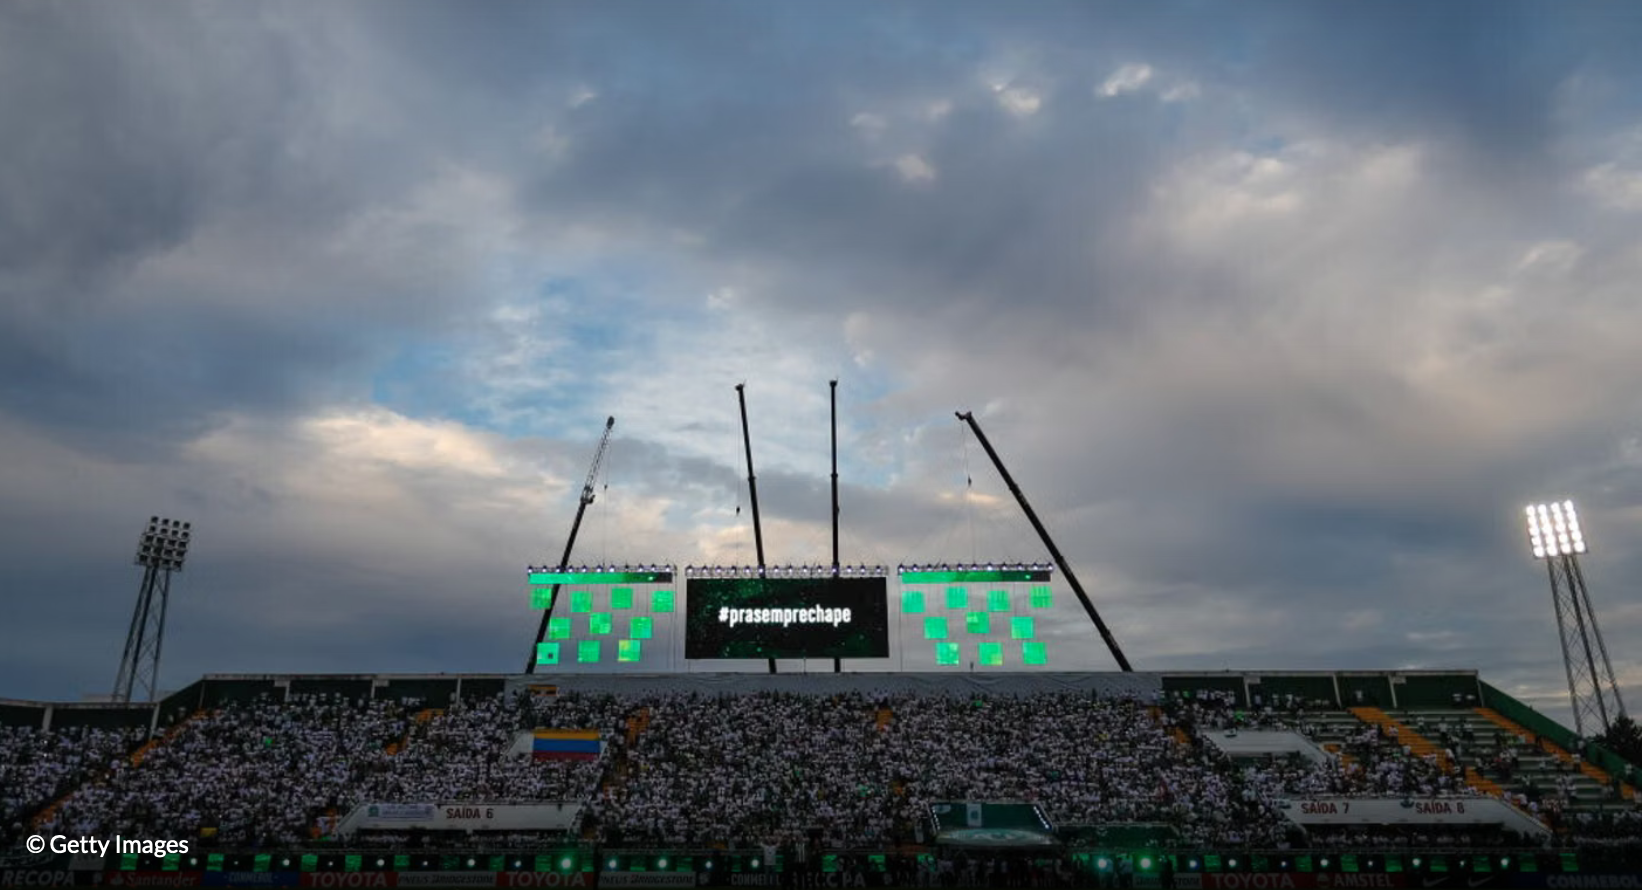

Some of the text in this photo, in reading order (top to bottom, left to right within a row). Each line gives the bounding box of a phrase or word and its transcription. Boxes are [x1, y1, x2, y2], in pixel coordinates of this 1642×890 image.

[718, 604, 851, 628] #prasemprechape
[446, 805, 481, 819] SAÍDA
[486, 808, 493, 819] 6
[1301, 801, 1349, 814] SAÍDA 7
[1415, 801, 1450, 814] SAÍDA
[2, 870, 75, 886] RECOPA
[126, 872, 197, 888] Santander
[309, 872, 388, 887] TOYOTA
[506, 871, 586, 887] TOYOTA
[1211, 873, 1295, 888] TOYOTA
[1335, 874, 1394, 888] AMSTEL
[1546, 874, 1642, 889] CONMEBOL
